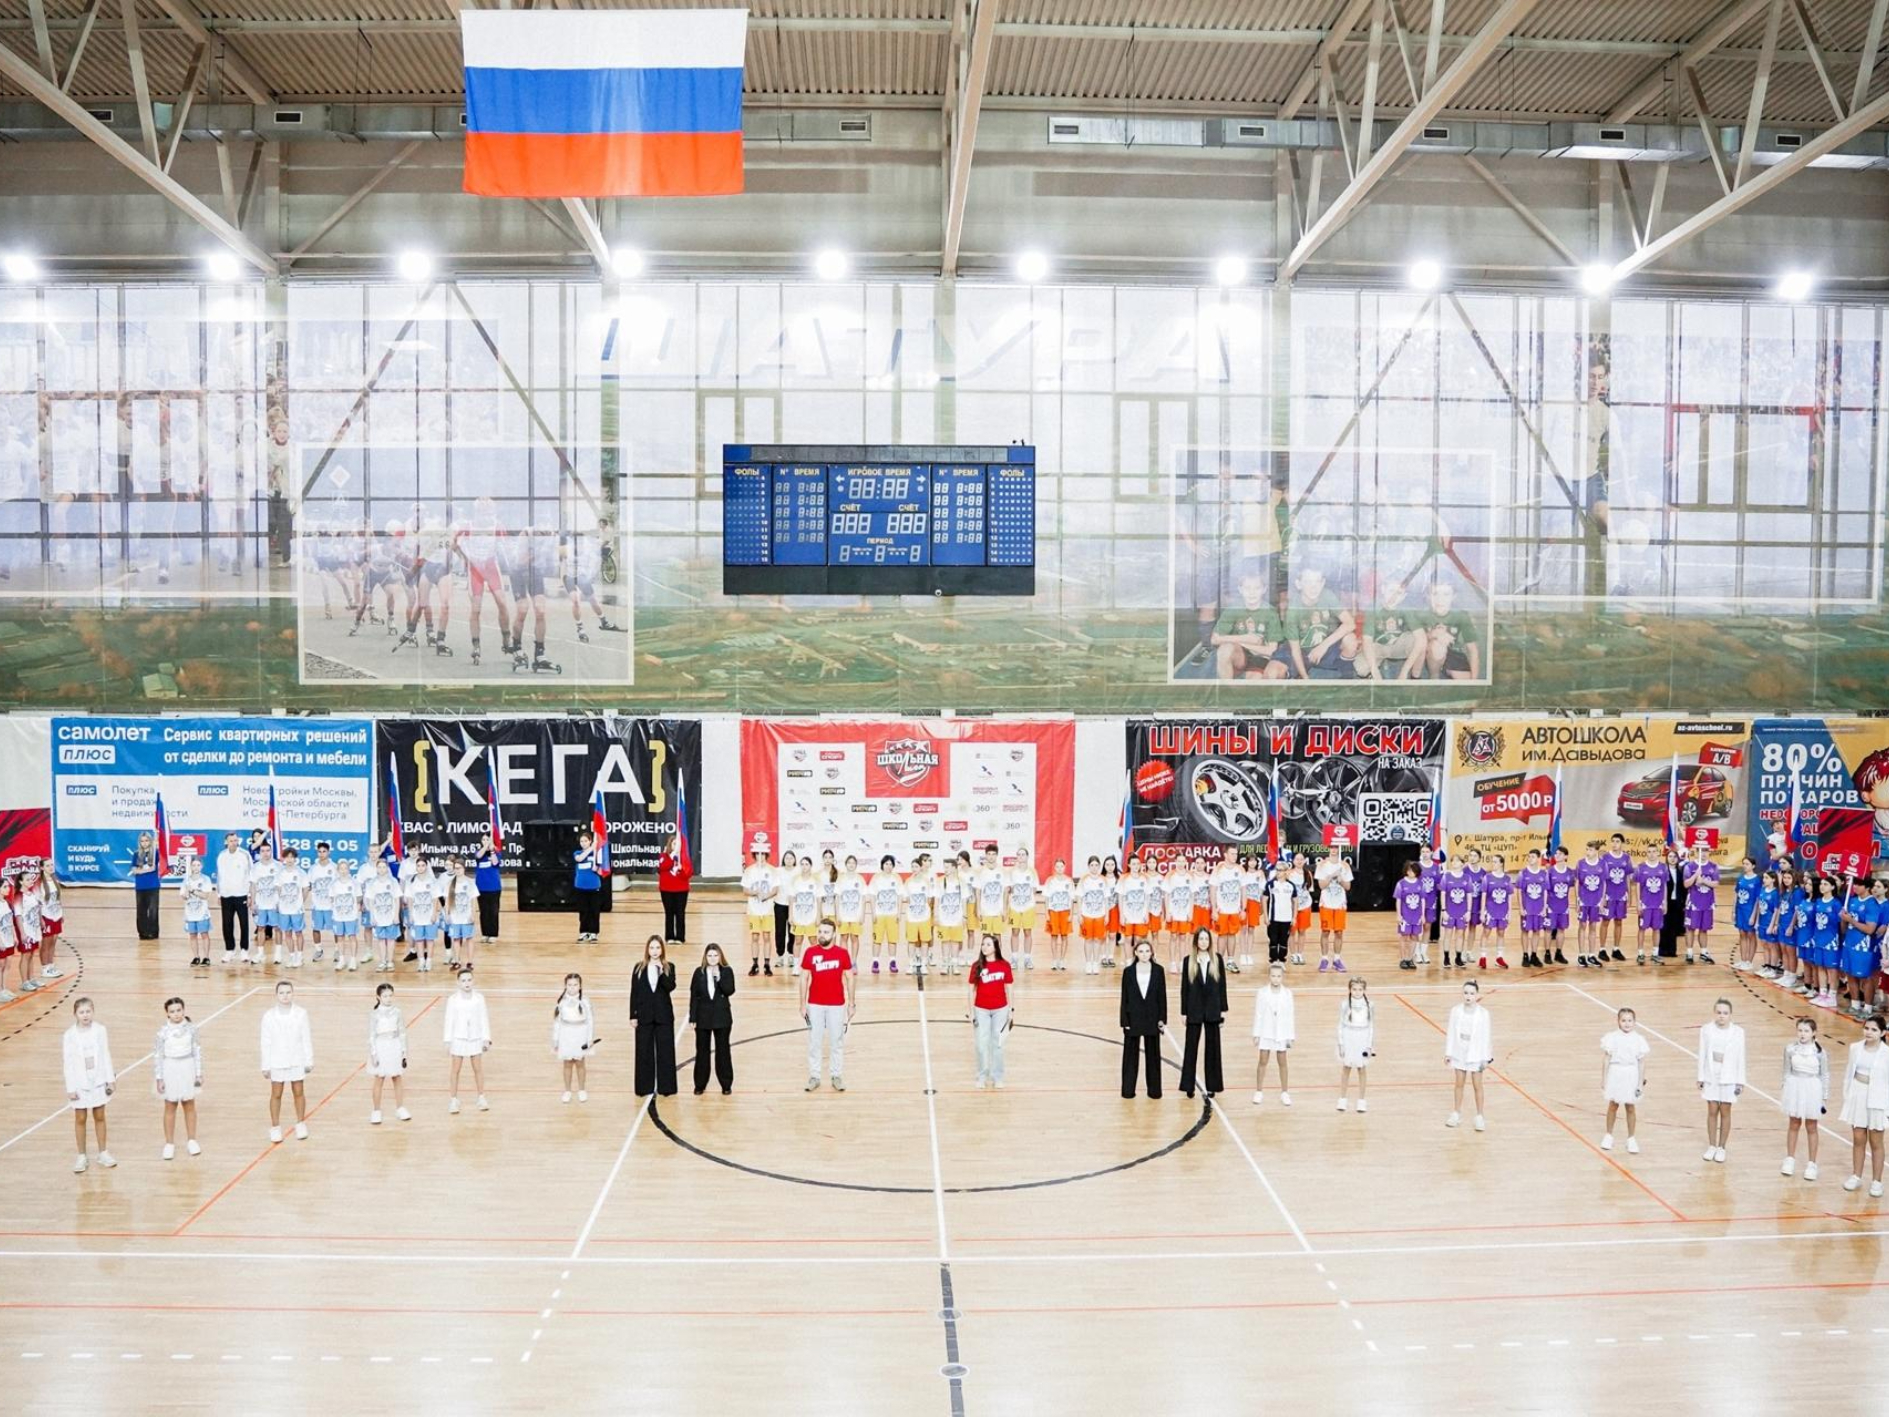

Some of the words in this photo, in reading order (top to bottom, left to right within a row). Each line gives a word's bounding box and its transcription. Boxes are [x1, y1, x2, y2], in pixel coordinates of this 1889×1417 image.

[848, 468, 882, 476] ИГРОВОЕ
[885, 468, 911, 476] ВРЕМЯ
[58, 726, 151, 741] самолет
[163, 727, 213, 745] Сервис
[219, 730, 299, 744] квартирных
[306, 729, 367, 746] решений
[1521, 726, 1647, 744] АВТОШКОЛА
[1149, 725, 1258, 755] ШИНЫ
[1270, 725, 1293, 755] И
[1304, 725, 1424, 757] ДИСКИ
[164, 752, 178, 763] от
[181, 752, 226, 765] сделки
[229, 752, 245, 765] до
[247, 752, 302, 766] ремонта
[305, 752, 314, 764] и
[316, 750, 367, 765] мебели
[877, 753, 939, 766] ШКОЛЬНАЯ
[1377, 758, 1391, 769] НА
[1393, 758, 1422, 769] ЗАКАЗ
[1762, 743, 1842, 772] 80%
[435, 743, 647, 805] КЕГА
[1477, 777, 1520, 791] ОБУЧЕНИЕ
[112, 786, 155, 796] Покупка
[243, 786, 310, 797] Новоройки
[312, 786, 357, 798] Москвы,
[121, 799, 157, 809] продаж
[243, 797, 304, 809] Москской
[307, 798, 350, 809] области
[1496, 791, 1541, 812] 5000
[112, 809, 188, 818] недвижиости
[251, 809, 347, 821] Са-Петербурга
[446, 821, 523, 836] ЛИМОАД
[591, 821, 677, 834] ОРОЖЕНО
[1475, 834, 1507, 844] Шатура,
[67, 844, 110, 853] СКАНИРУЙ
[337, 840, 358, 852] 05
[421, 844, 459, 854] Ильича
[611, 843, 661, 854] Школьная
[1481, 844, 1491, 853] ТЦ
[1144, 846, 1221, 859] ДОСТАВКА
[76, 855, 96, 864] БУДЬ
